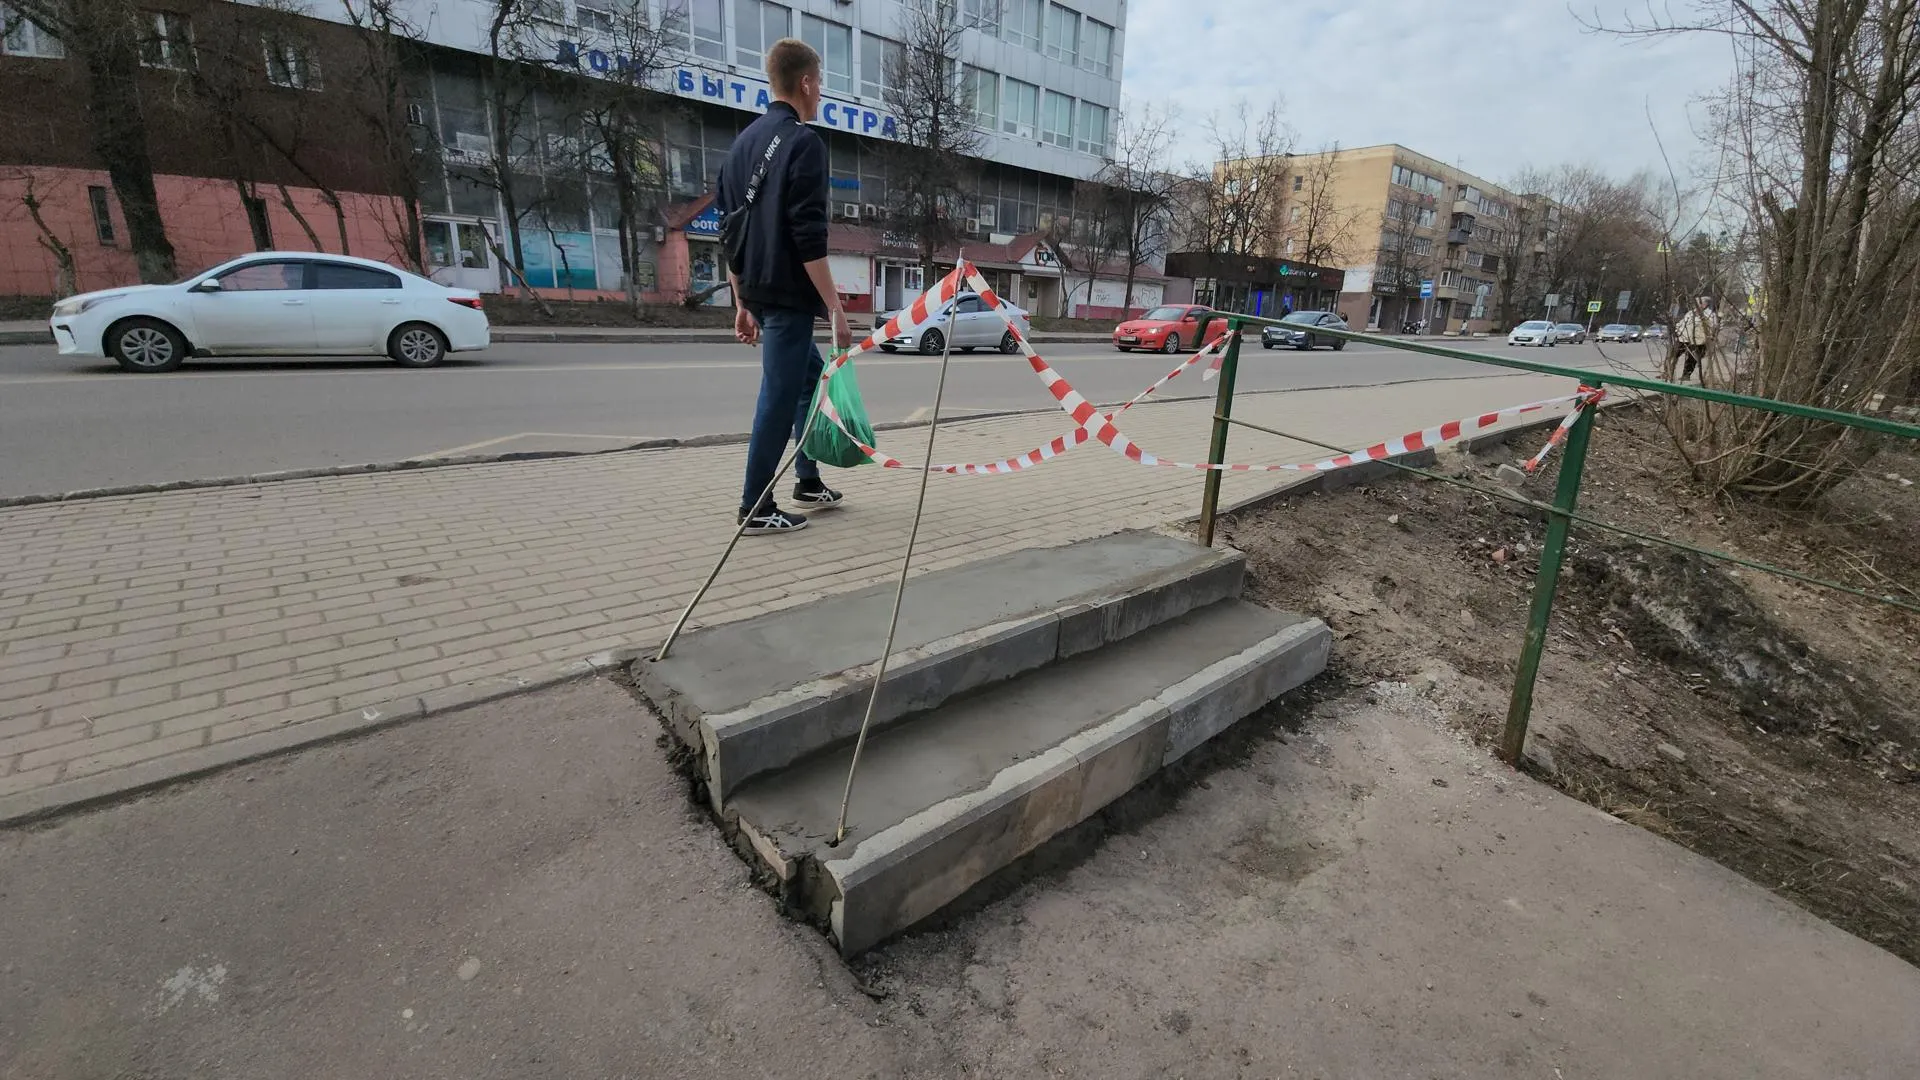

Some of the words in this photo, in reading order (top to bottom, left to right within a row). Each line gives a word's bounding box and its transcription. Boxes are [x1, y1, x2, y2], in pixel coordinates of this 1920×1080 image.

[678, 69, 770, 108] БЫТА
[816, 102, 898, 140] СТРА
[764, 135, 781, 161] NIKE
